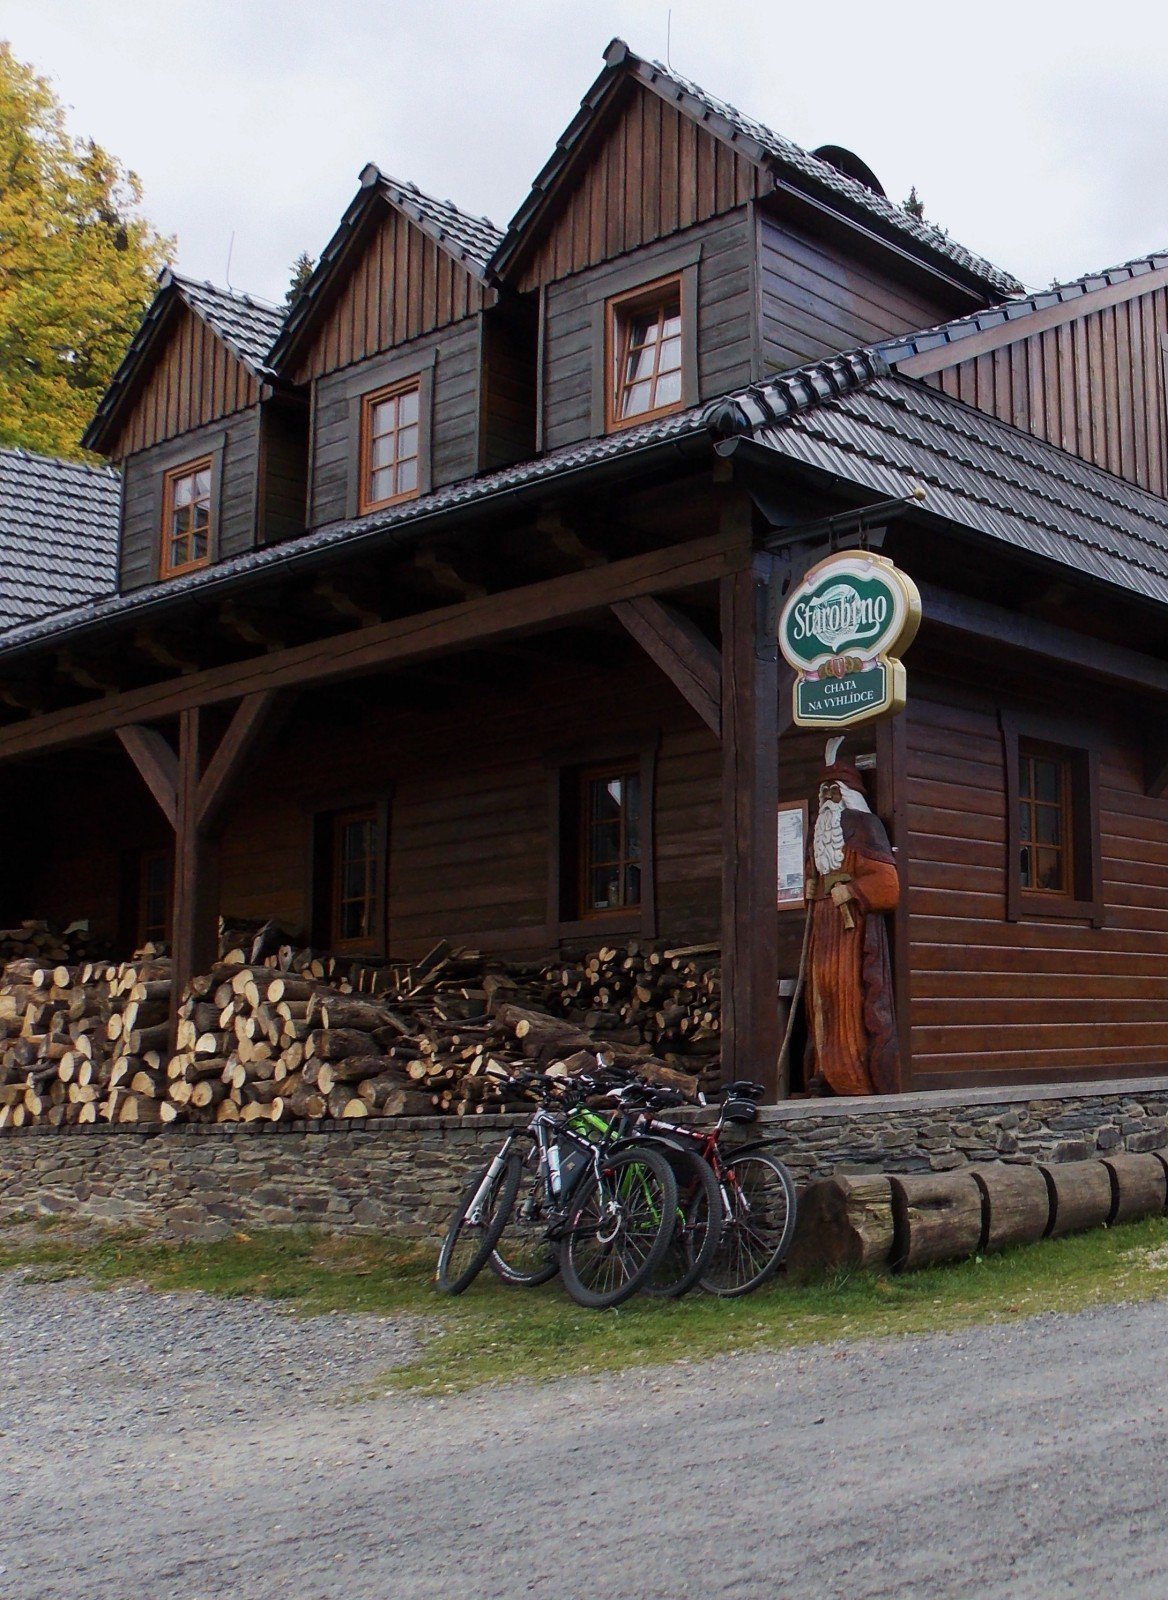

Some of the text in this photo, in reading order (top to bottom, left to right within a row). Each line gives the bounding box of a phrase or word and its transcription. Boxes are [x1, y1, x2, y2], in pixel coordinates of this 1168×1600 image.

[793, 594, 887, 640] Starobrno
[824, 680, 857, 694] CHATA
[808, 690, 874, 712] NA VYHLÍDCE
